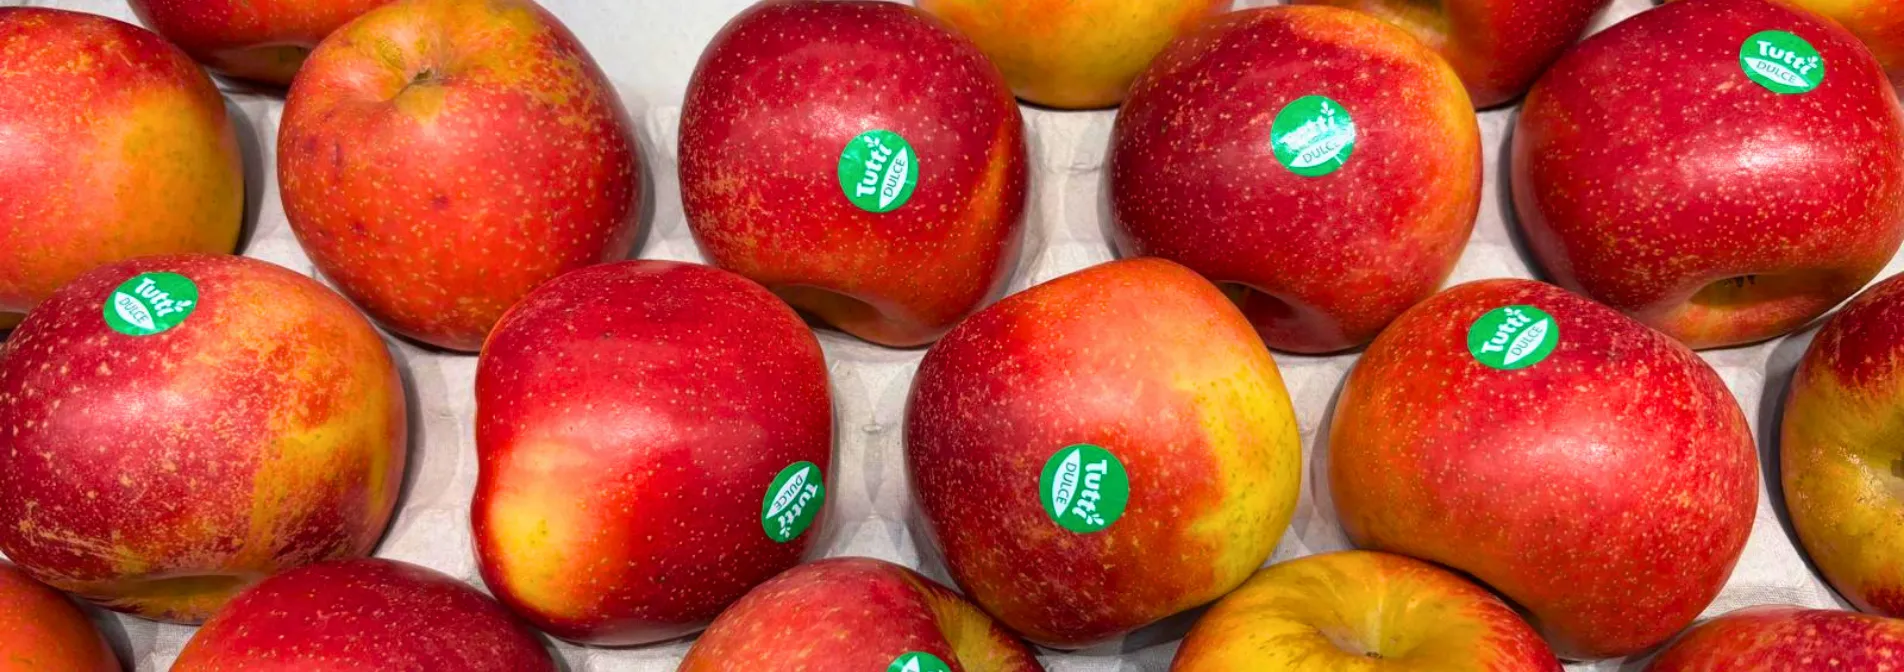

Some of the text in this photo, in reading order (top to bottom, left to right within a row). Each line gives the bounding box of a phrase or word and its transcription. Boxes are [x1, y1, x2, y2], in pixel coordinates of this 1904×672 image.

[1756, 61, 1796, 82] DULCE
[1757, 41, 1817, 74] Tutti
[856, 136, 892, 197] Tutti
[883, 158, 905, 197] DULCE
[119, 297, 148, 322] DULCE
[135, 277, 192, 317] Tutti
[1481, 307, 1531, 353] Tutti
[1511, 326, 1543, 356] DULCE
[775, 474, 803, 510] DULCE
[1055, 462, 1077, 505] DULCE
[1072, 459, 1107, 526] Tutti
[778, 483, 818, 538] Tutti
